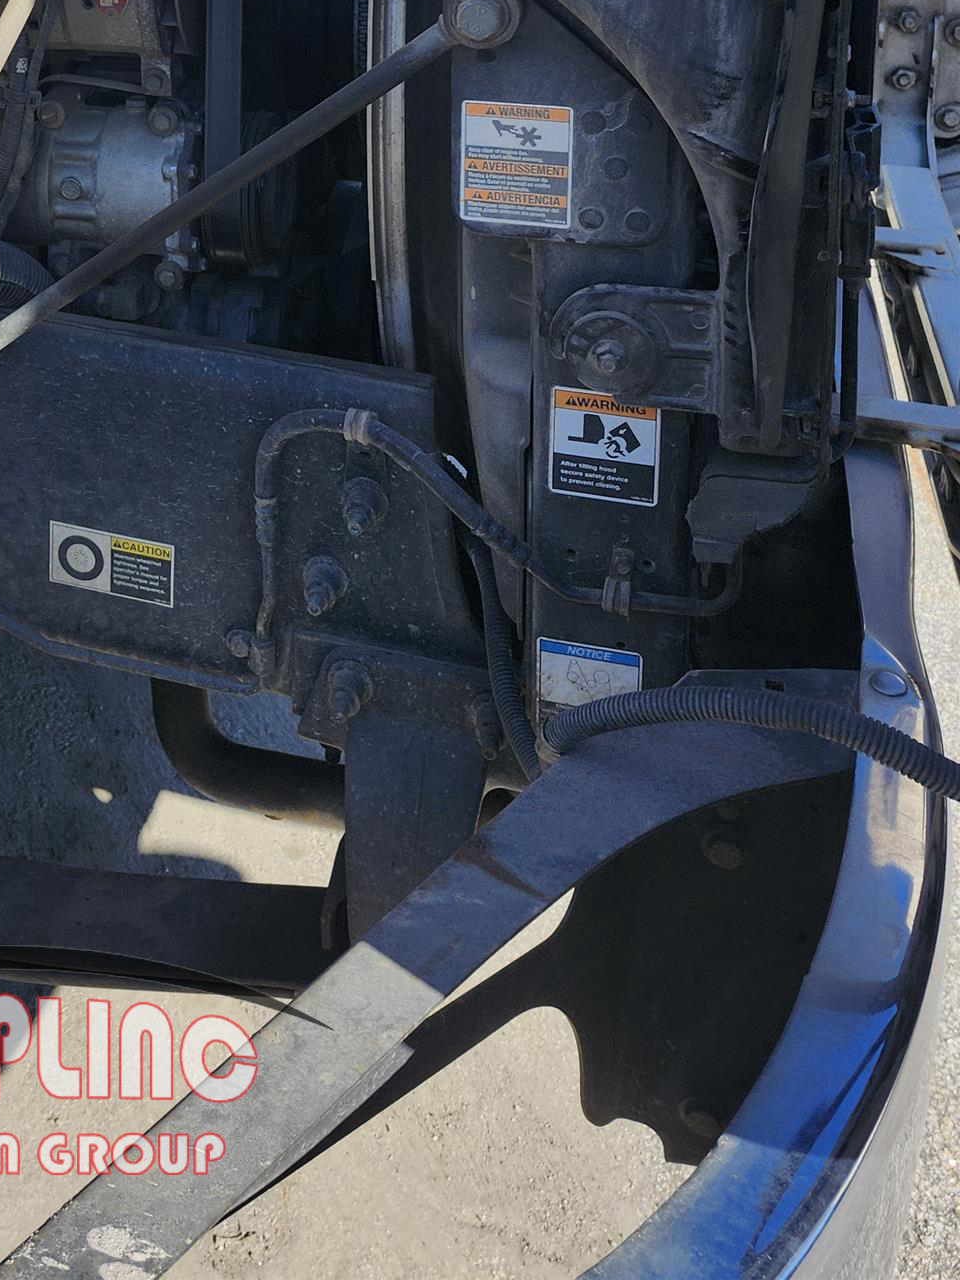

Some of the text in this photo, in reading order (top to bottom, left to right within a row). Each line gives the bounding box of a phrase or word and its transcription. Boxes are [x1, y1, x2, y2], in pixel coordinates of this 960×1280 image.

[499, 106, 551, 119] WARNING
[482, 160, 566, 176] AVERTISSEMENT
[487, 191, 561, 206] ADVERTENCIA
[576, 396, 646, 415] WARNING
[560, 469, 629, 483] secure safety device
[599, 465, 617, 473] hood
[568, 478, 595, 486] prevent
[122, 541, 170, 558] CAUTION
[566, 645, 613, 662] NOTICE
